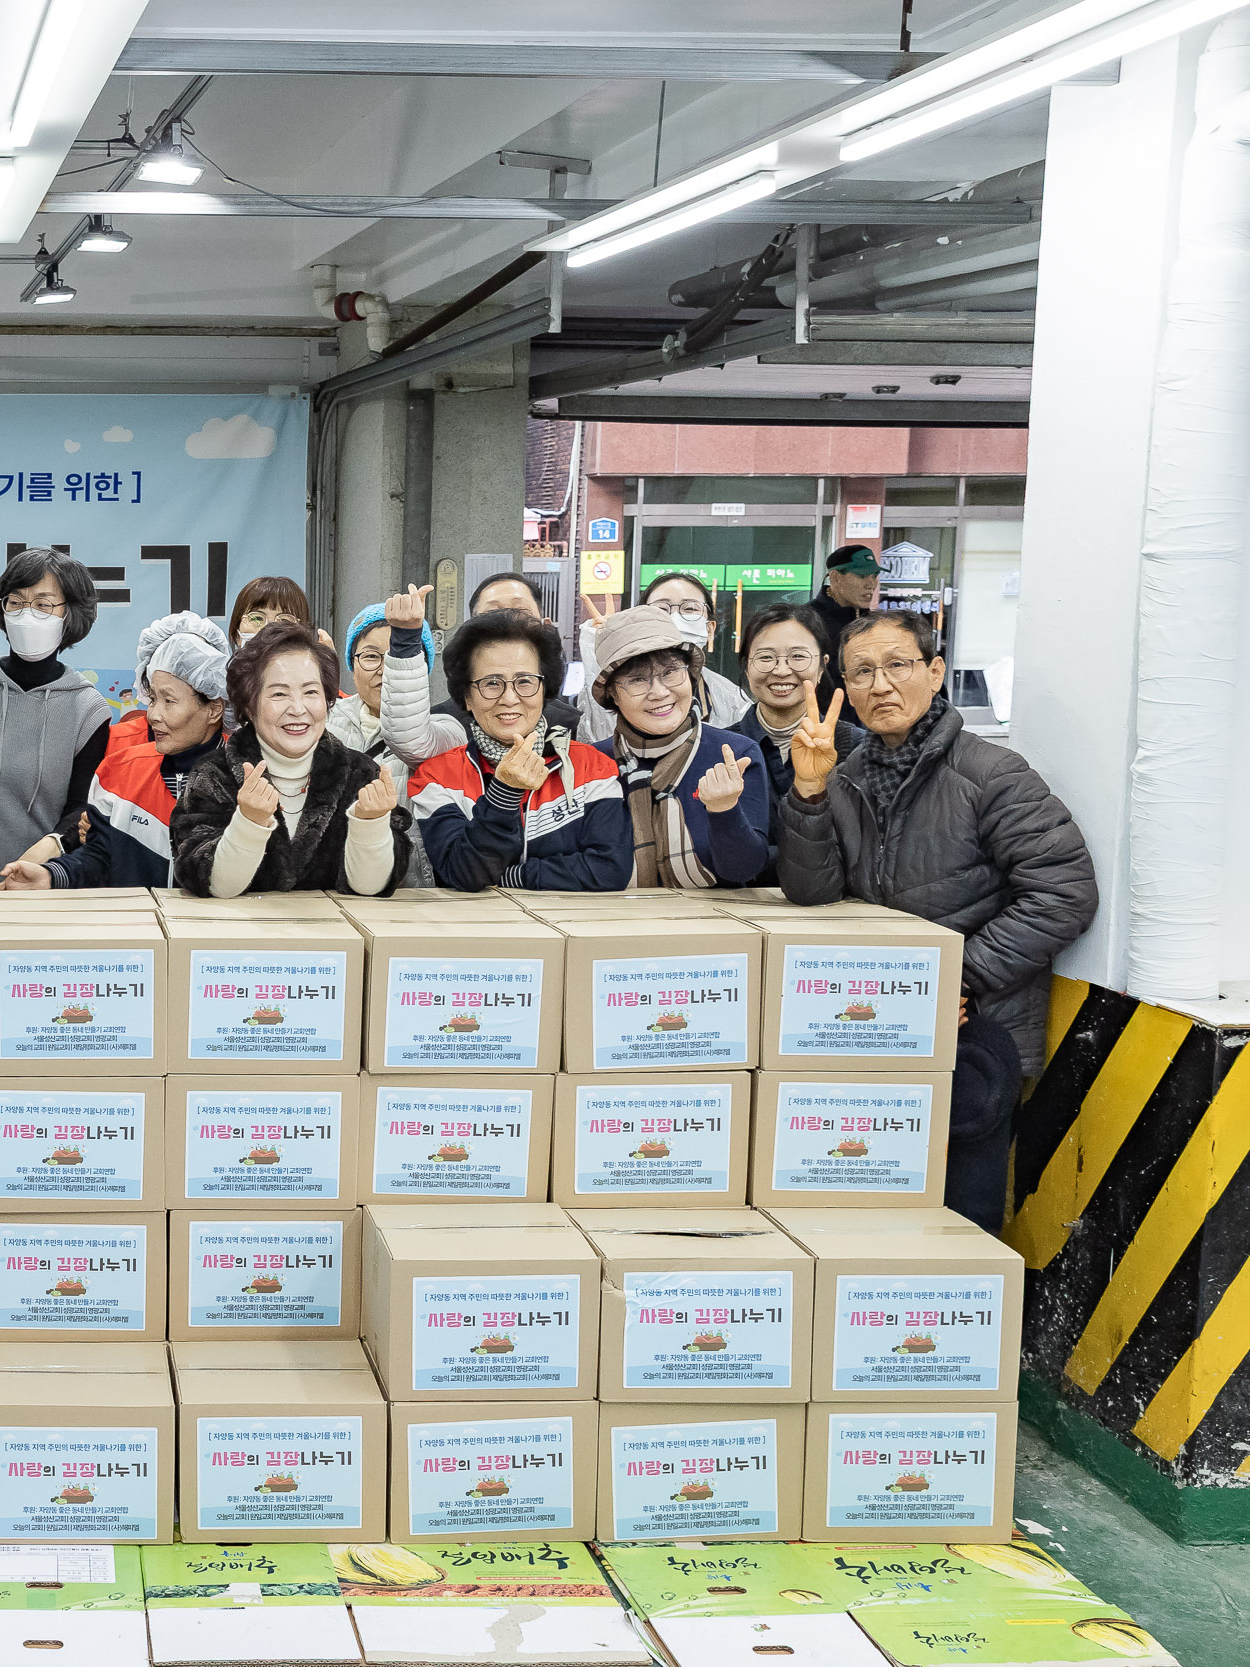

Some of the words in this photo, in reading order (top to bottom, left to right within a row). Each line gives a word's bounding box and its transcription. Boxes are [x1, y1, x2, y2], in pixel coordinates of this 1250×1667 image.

[63, 470, 123, 502] 위한
[597, 529, 611, 539] 14
[131, 814, 150, 826] FILA
[12, 984, 56, 998] 사랑의
[63, 983, 144, 998] 김장나누기
[796, 979, 841, 994] 사랑의
[847, 980, 929, 995] 김장나누기
[401, 992, 445, 1006] 사랑의
[451, 992, 531, 1007] 김장나누기
[607, 991, 651, 1007] 사랑의
[658, 988, 738, 1005] 김장나누기
[3, 1124, 47, 1139] 사랑의
[54, 1125, 134, 1140] 김장나누기
[389, 1121, 434, 1136] 사랑의
[440, 1122, 521, 1138] 김장나누기
[790, 1116, 834, 1131] 사랑의
[840, 1117, 921, 1132] 김장나누기
[203, 1254, 247, 1268] 사랑의
[253, 1254, 332, 1268] 김장나누기
[429, 1294, 450, 1302] 자양동
[452, 1293, 466, 1301] 지역
[468, 1293, 489, 1301] 주민의
[491, 1292, 511, 1300] 따뜻한
[513, 1292, 548, 1300] 겨울나기를
[550, 1292, 564, 1300] 위한
[428, 1312, 475, 1328] 사랑의
[482, 1311, 569, 1327] 김장나누기
[640, 1308, 687, 1324] 사랑의
[694, 1308, 782, 1324] 김장나누기
[850, 1311, 898, 1326] 사랑의
[905, 1310, 991, 1326] 김장나누기
[423, 1456, 470, 1473] 사랑의
[477, 1452, 562, 1471] 김장나누기
[843, 1450, 891, 1465] 사랑의
[898, 1449, 985, 1465] 김장나누기
[8, 1462, 55, 1477] 사랑의
[62, 1463, 147, 1477] 김장나누기
[627, 1460, 674, 1477] 사랑의
[681, 1455, 767, 1474] 김장나누기
[437, 1543, 570, 1570] 절임배추
[185, 1555, 278, 1575] 절임배추
[666, 1556, 763, 1576] 절임배추
[832, 1556, 972, 1585] 절임배추
